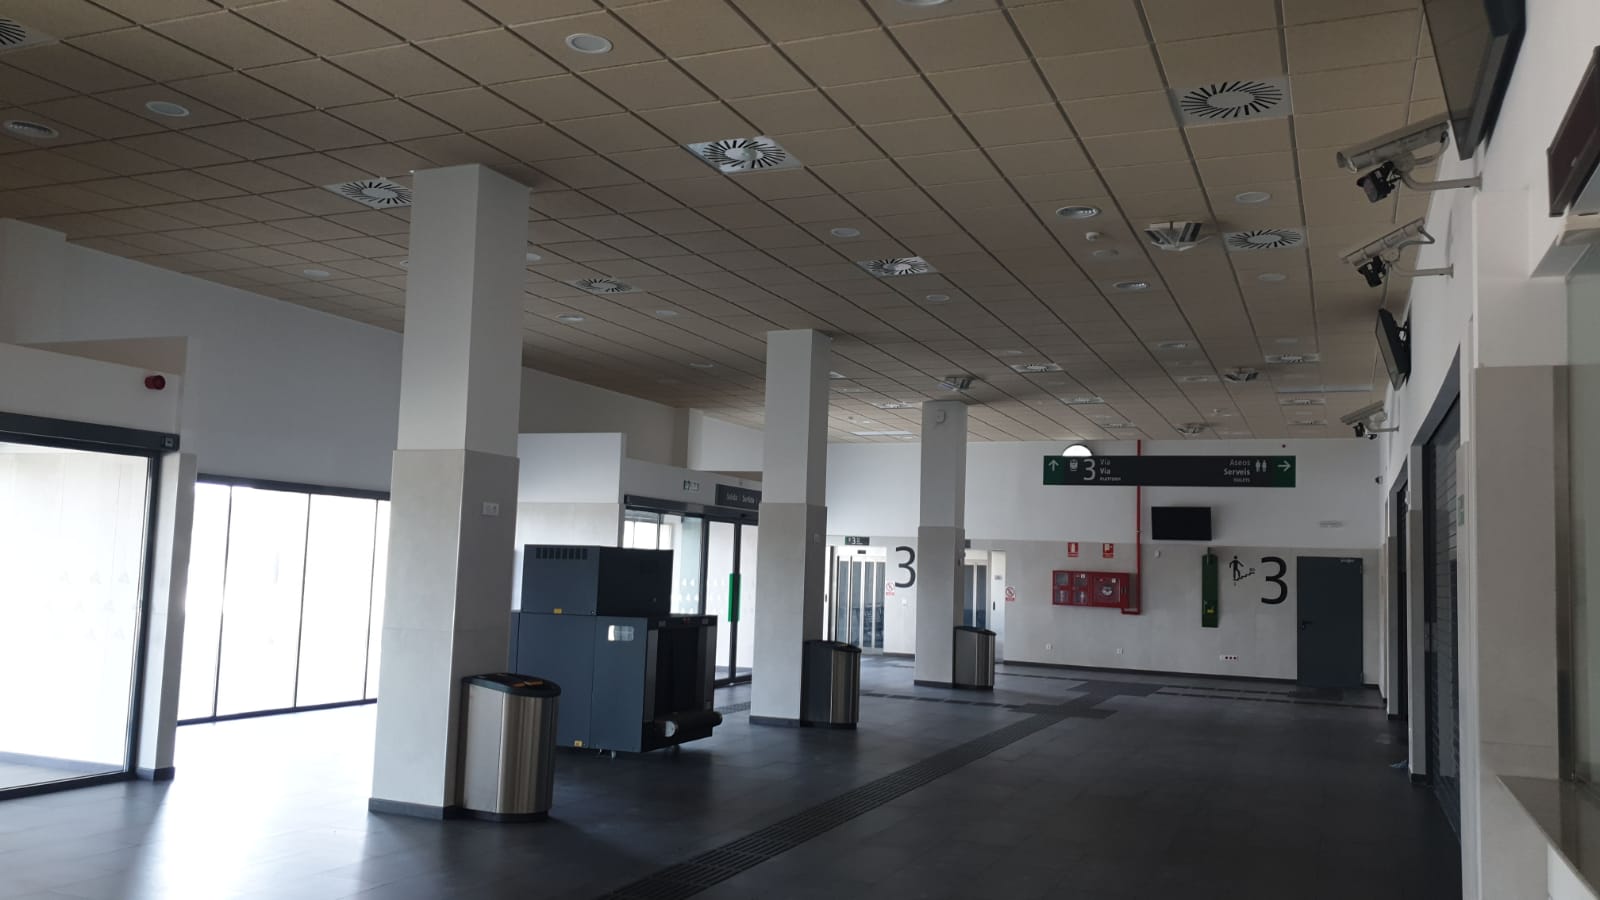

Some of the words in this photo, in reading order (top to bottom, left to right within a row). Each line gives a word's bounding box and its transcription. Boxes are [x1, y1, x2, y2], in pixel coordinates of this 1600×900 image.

[1083, 458, 1096, 481] 3
[1223, 467, 1250, 476] Serveis
[895, 545, 916, 588] 3
[1261, 556, 1288, 605] 3
